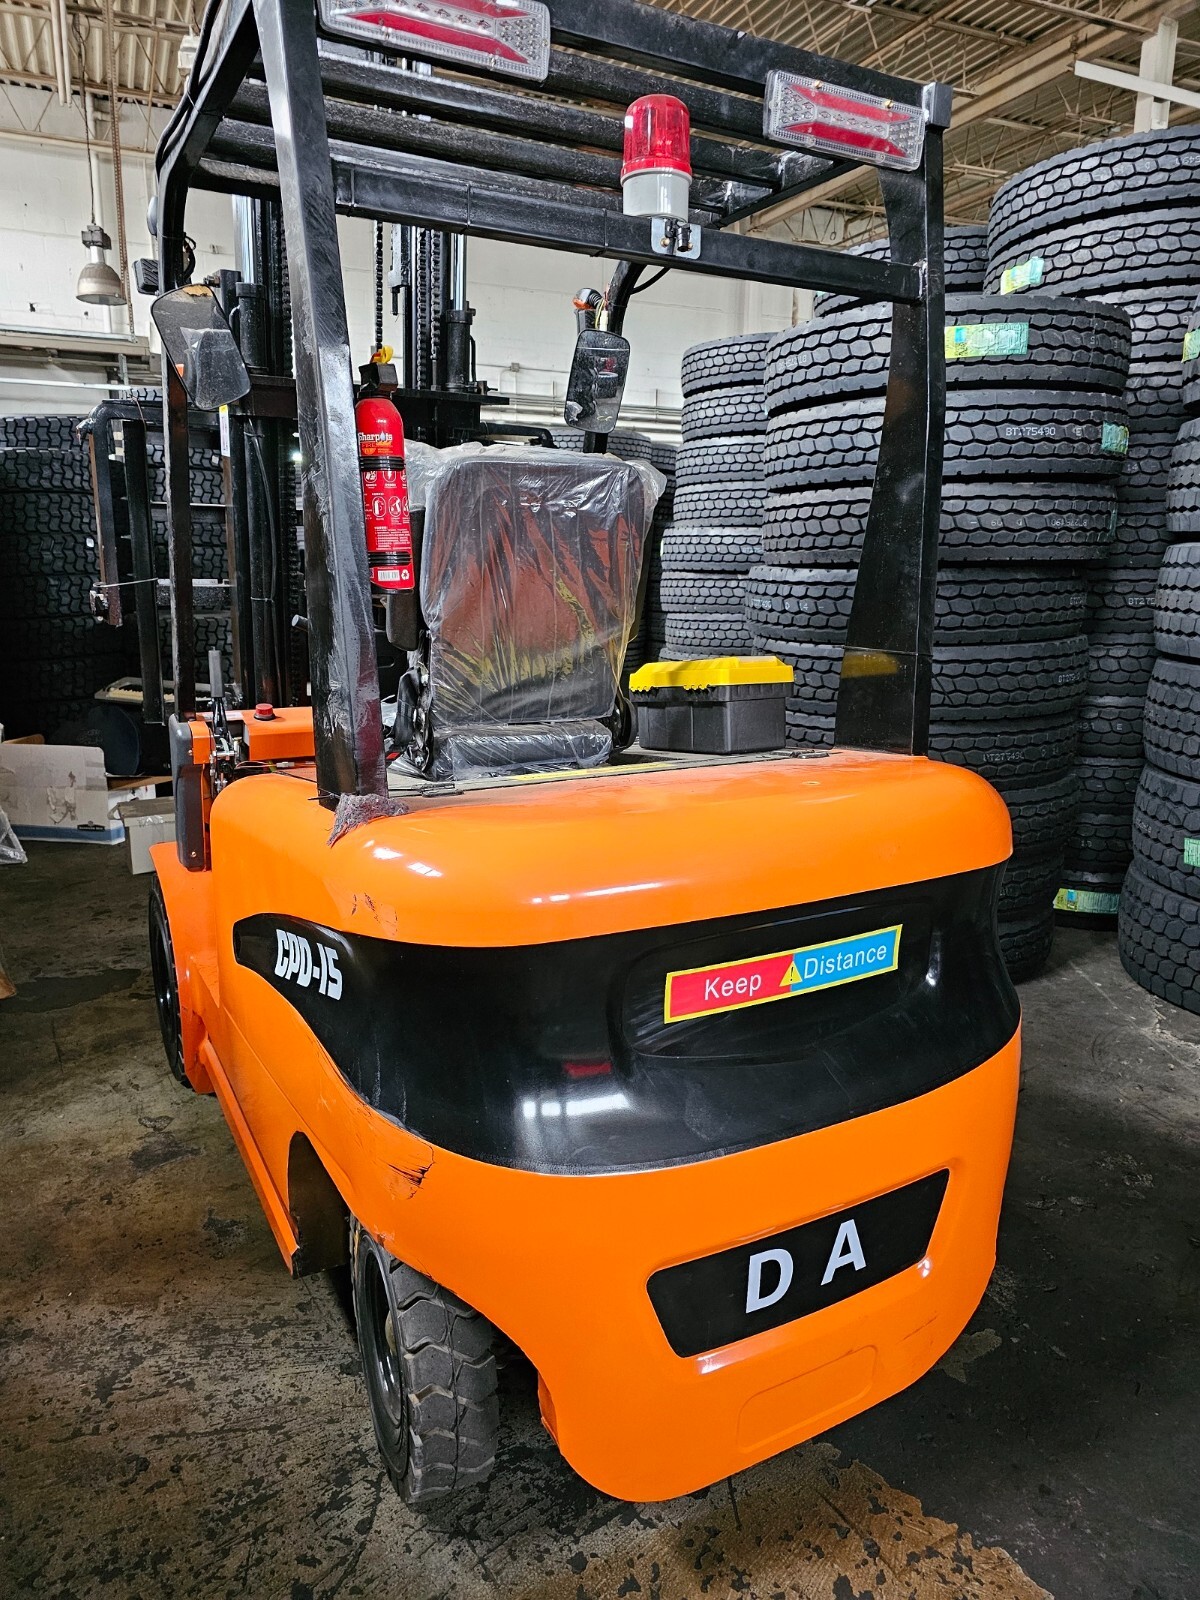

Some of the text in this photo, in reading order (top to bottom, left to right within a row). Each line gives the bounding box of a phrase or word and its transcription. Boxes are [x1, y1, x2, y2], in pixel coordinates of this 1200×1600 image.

[274, 928, 343, 1001] CPD-15
[704, 944, 888, 1001] Keep Distance
